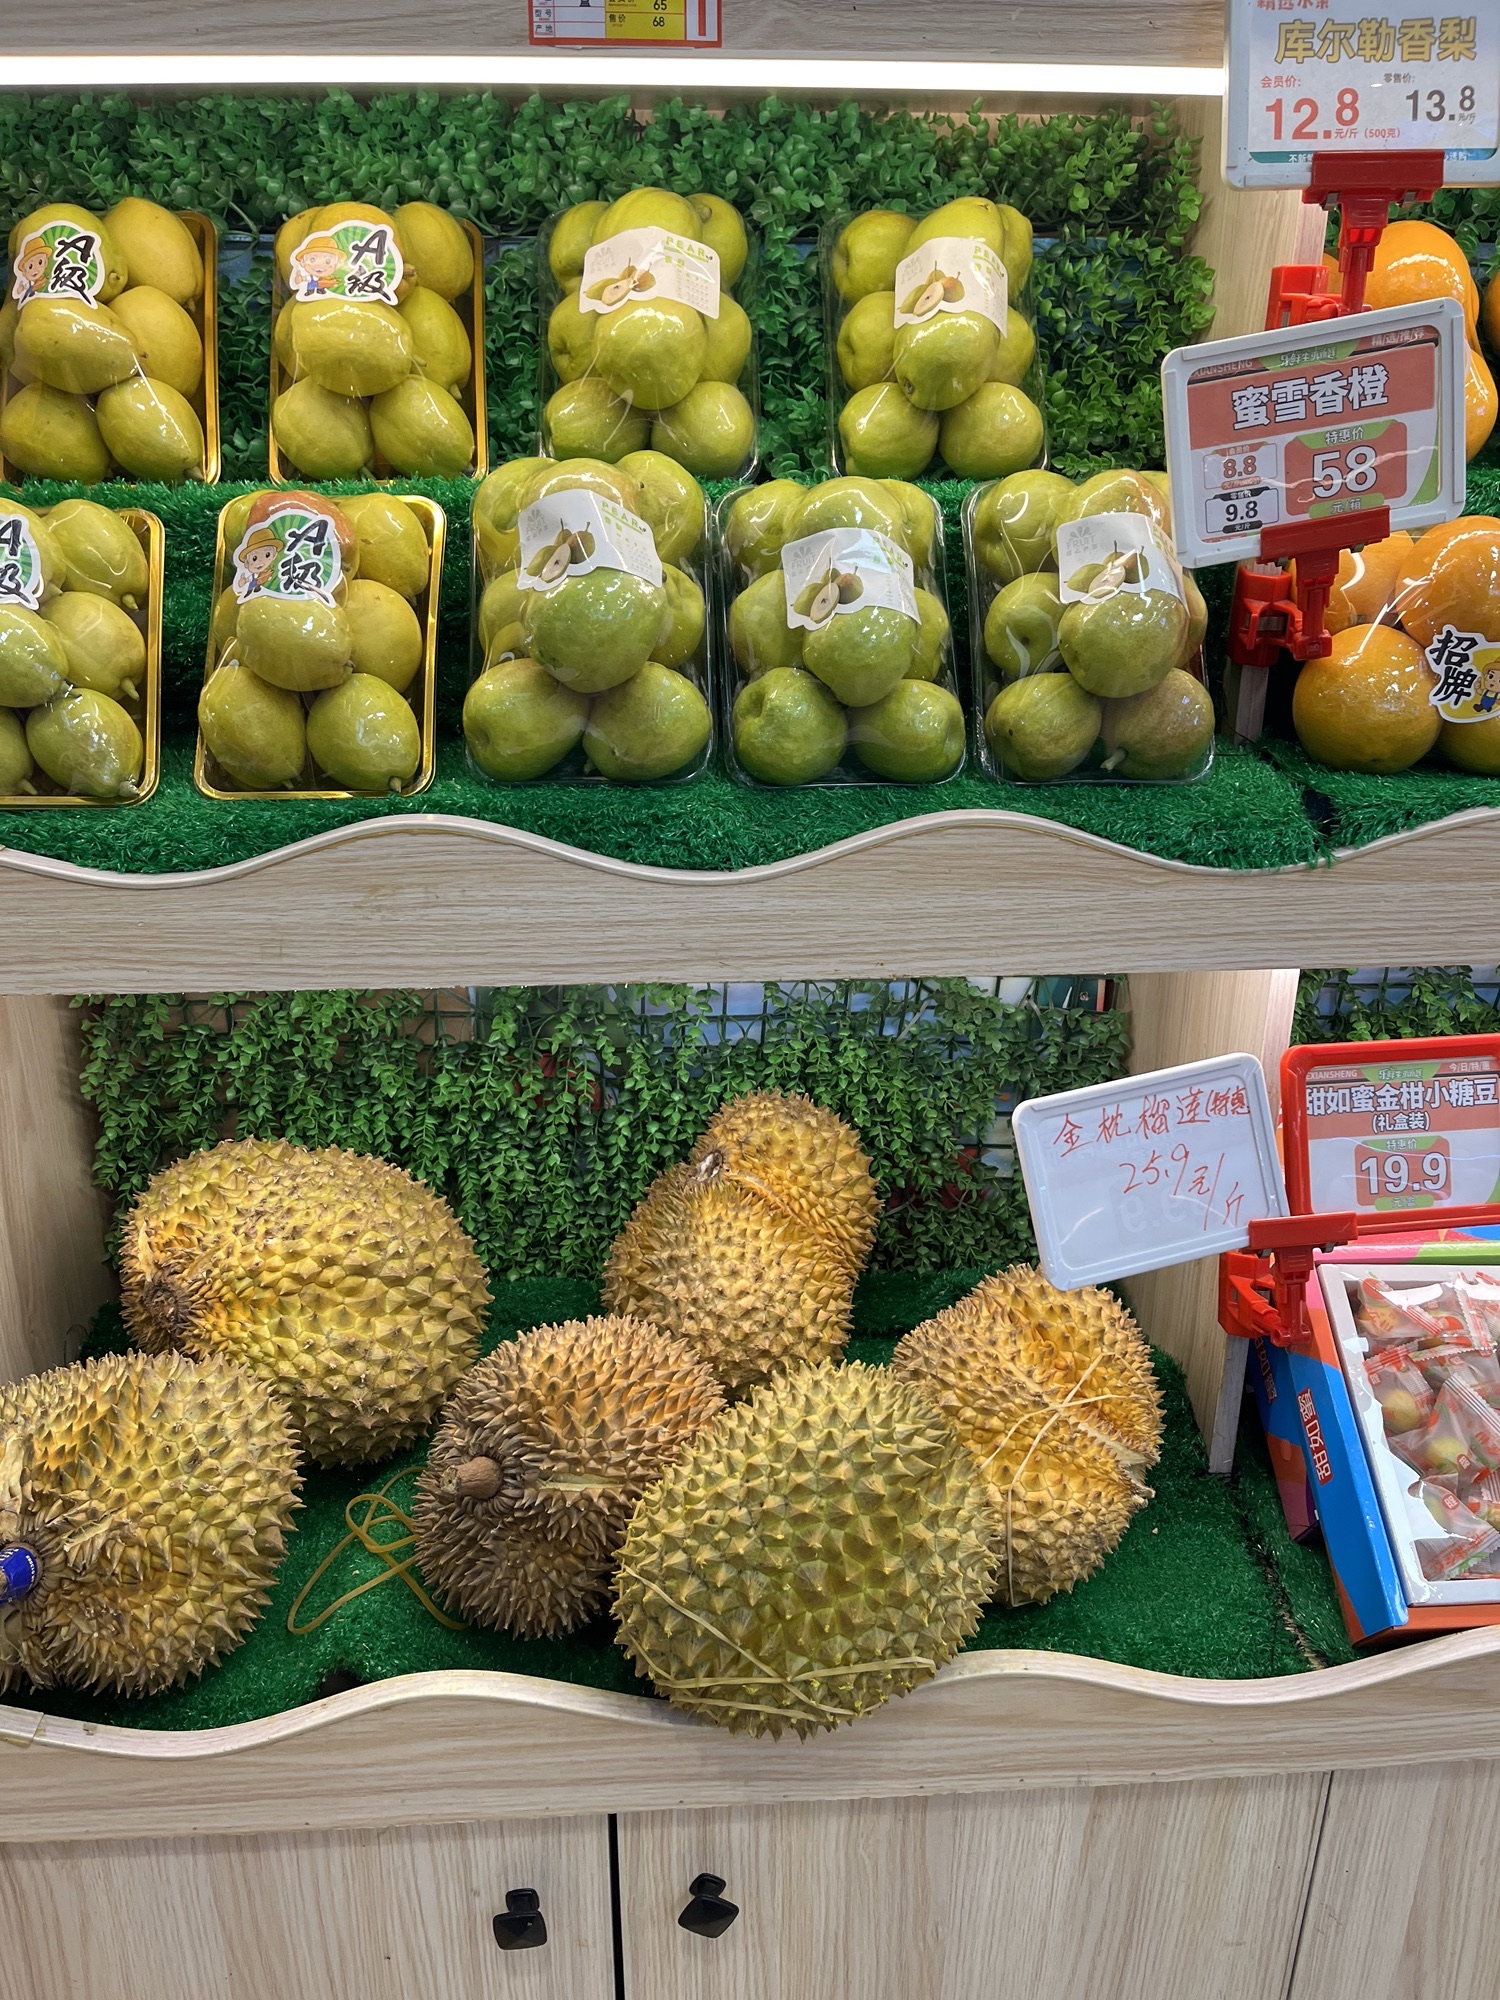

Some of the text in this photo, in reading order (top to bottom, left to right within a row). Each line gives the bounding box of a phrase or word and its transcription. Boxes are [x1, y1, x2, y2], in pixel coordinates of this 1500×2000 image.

[609, 13, 626, 23] 售价
[652, 16, 665, 27] 68
[1274, 16, 1477, 64] 库尔勒香梨
[1265, 88, 1360, 141] 12.8
[1405, 85, 1476, 122] 13.8
[665, 236, 706, 258] PEAR
[1231, 363, 1389, 430] 蜜雪香橙
[1325, 426, 1365, 444] 特惠价
[1223, 455, 1257, 479] 8.8
[1312, 445, 1378, 499] 58
[601, 500, 639, 528] PEAR
[1225, 500, 1258, 522] 9.8
[1066, 535, 1096, 550] FRUIT
[1429, 629, 1479, 706] 招牌
[1306, 1077, 1499, 1117] 甜如蜜金柑小糖豆
[1372, 1111, 1430, 1134] (礼盒装)
[1386, 1139, 1418, 1151] 特惠价
[1360, 1151, 1448, 1195] 19.9
[1299, 1389, 1331, 1481] 甜如蜜
